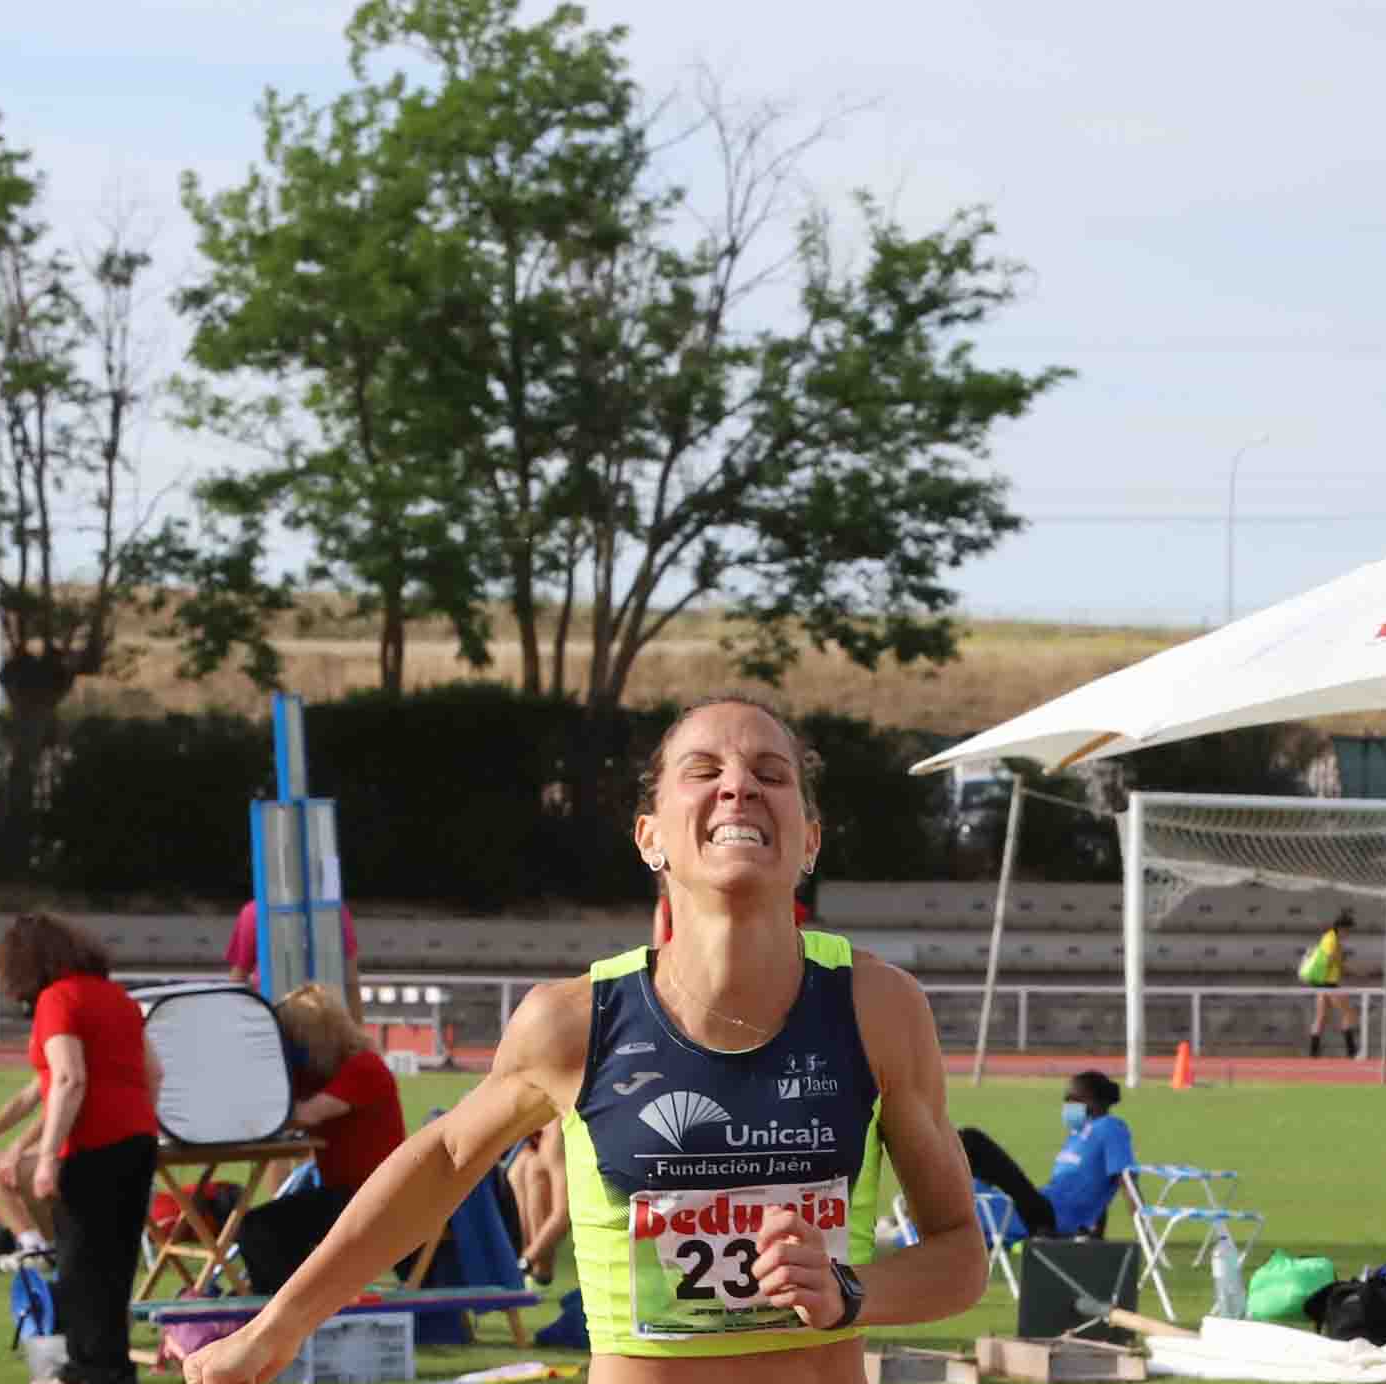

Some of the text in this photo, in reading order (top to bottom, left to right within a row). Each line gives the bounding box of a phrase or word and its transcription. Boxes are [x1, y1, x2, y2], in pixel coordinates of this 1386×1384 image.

[725, 1118, 836, 1149] Unicaja
[657, 1157, 812, 1177] Fundación Jaén
